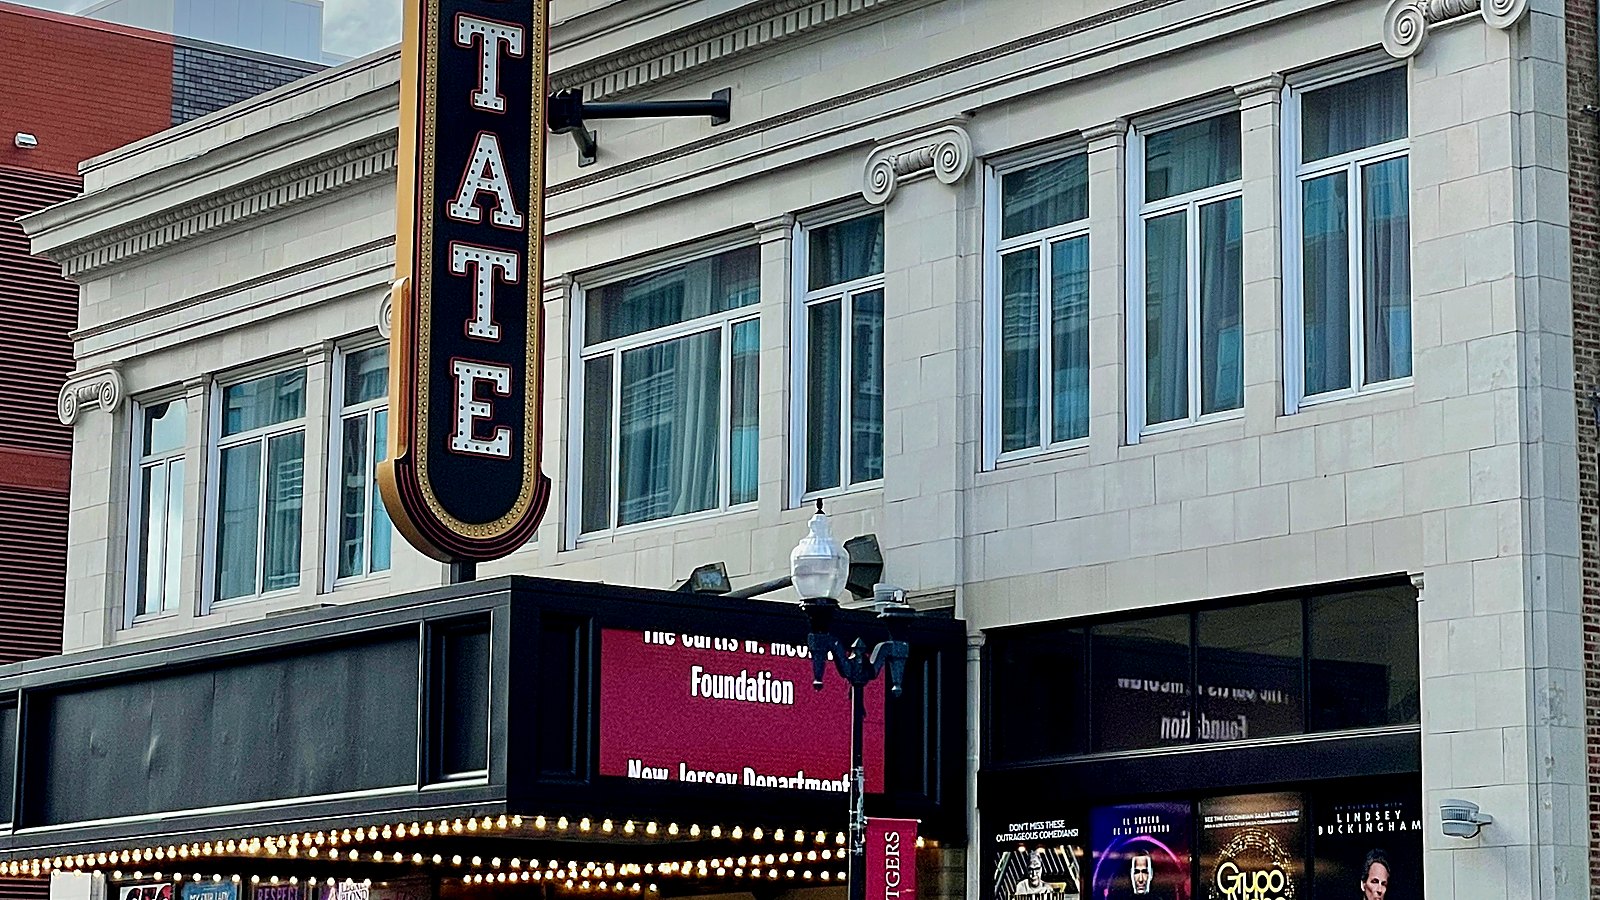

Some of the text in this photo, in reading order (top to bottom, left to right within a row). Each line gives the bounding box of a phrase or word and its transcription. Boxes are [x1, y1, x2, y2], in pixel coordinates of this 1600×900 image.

[691, 666, 795, 704] Foundation
[1336, 809, 1402, 823] LINDSEY
[1009, 819, 1066, 832] DON'T MISS THESE
[1318, 819, 1422, 836] BUCKINGHAM
[996, 831, 1038, 842] OUTRAGEOUS
